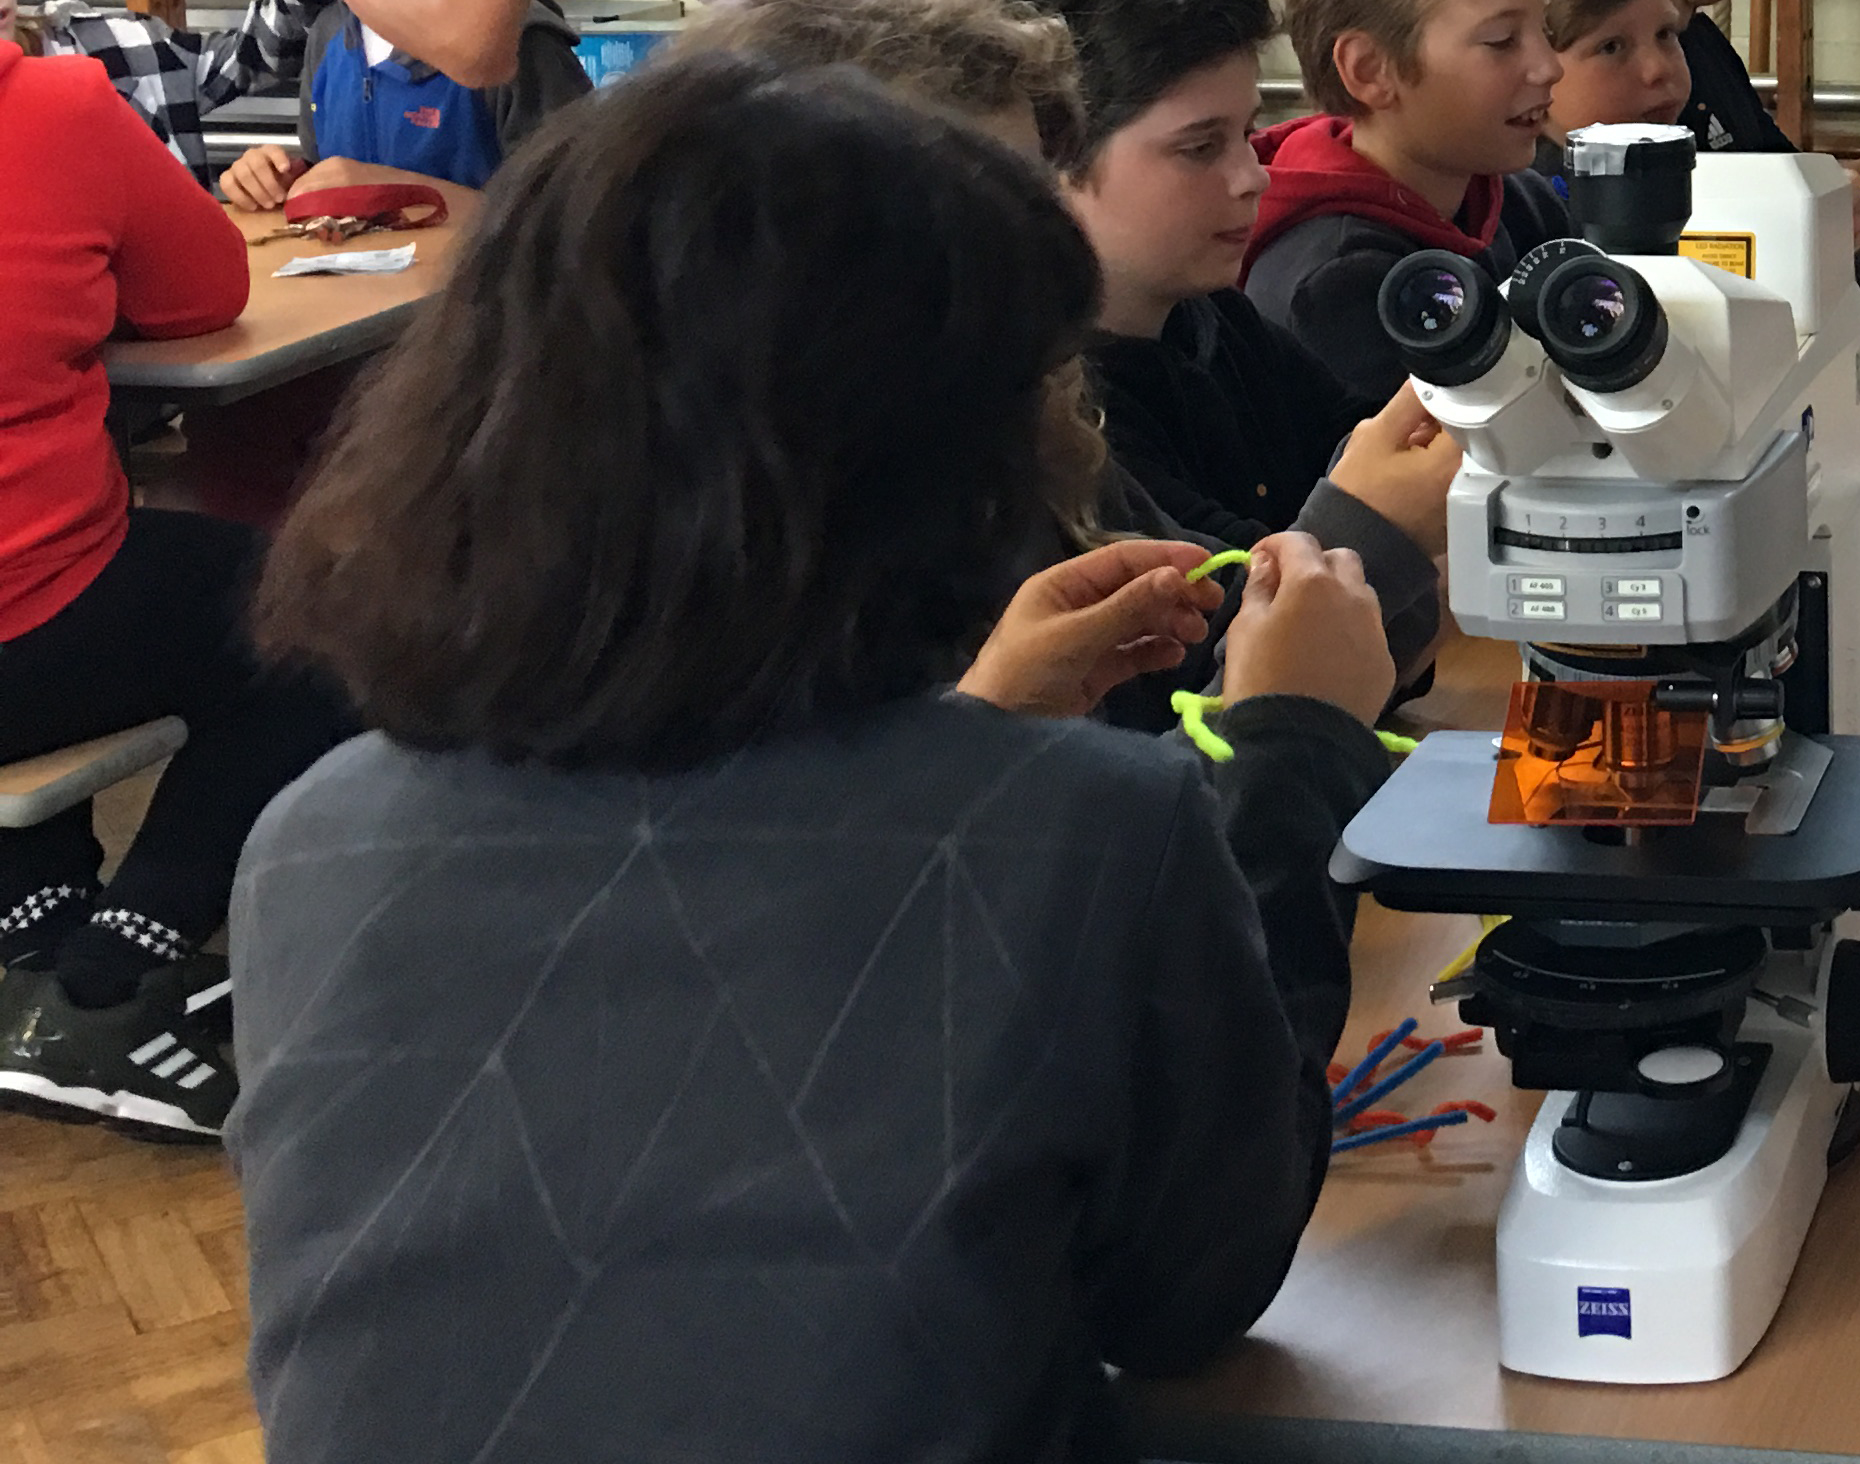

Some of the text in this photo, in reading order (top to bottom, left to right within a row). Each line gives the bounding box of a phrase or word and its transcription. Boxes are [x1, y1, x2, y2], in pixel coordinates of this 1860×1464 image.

[1525, 514, 1646, 530] 1 2 3 4
[1686, 523, 1710, 535] lock
[1511, 579, 1517, 591] 1
[1605, 582, 1613, 593] 3
[1511, 605, 1519, 615] 2
[1605, 605, 1613, 616] 4
[1579, 1301, 1629, 1316] ZEISS
